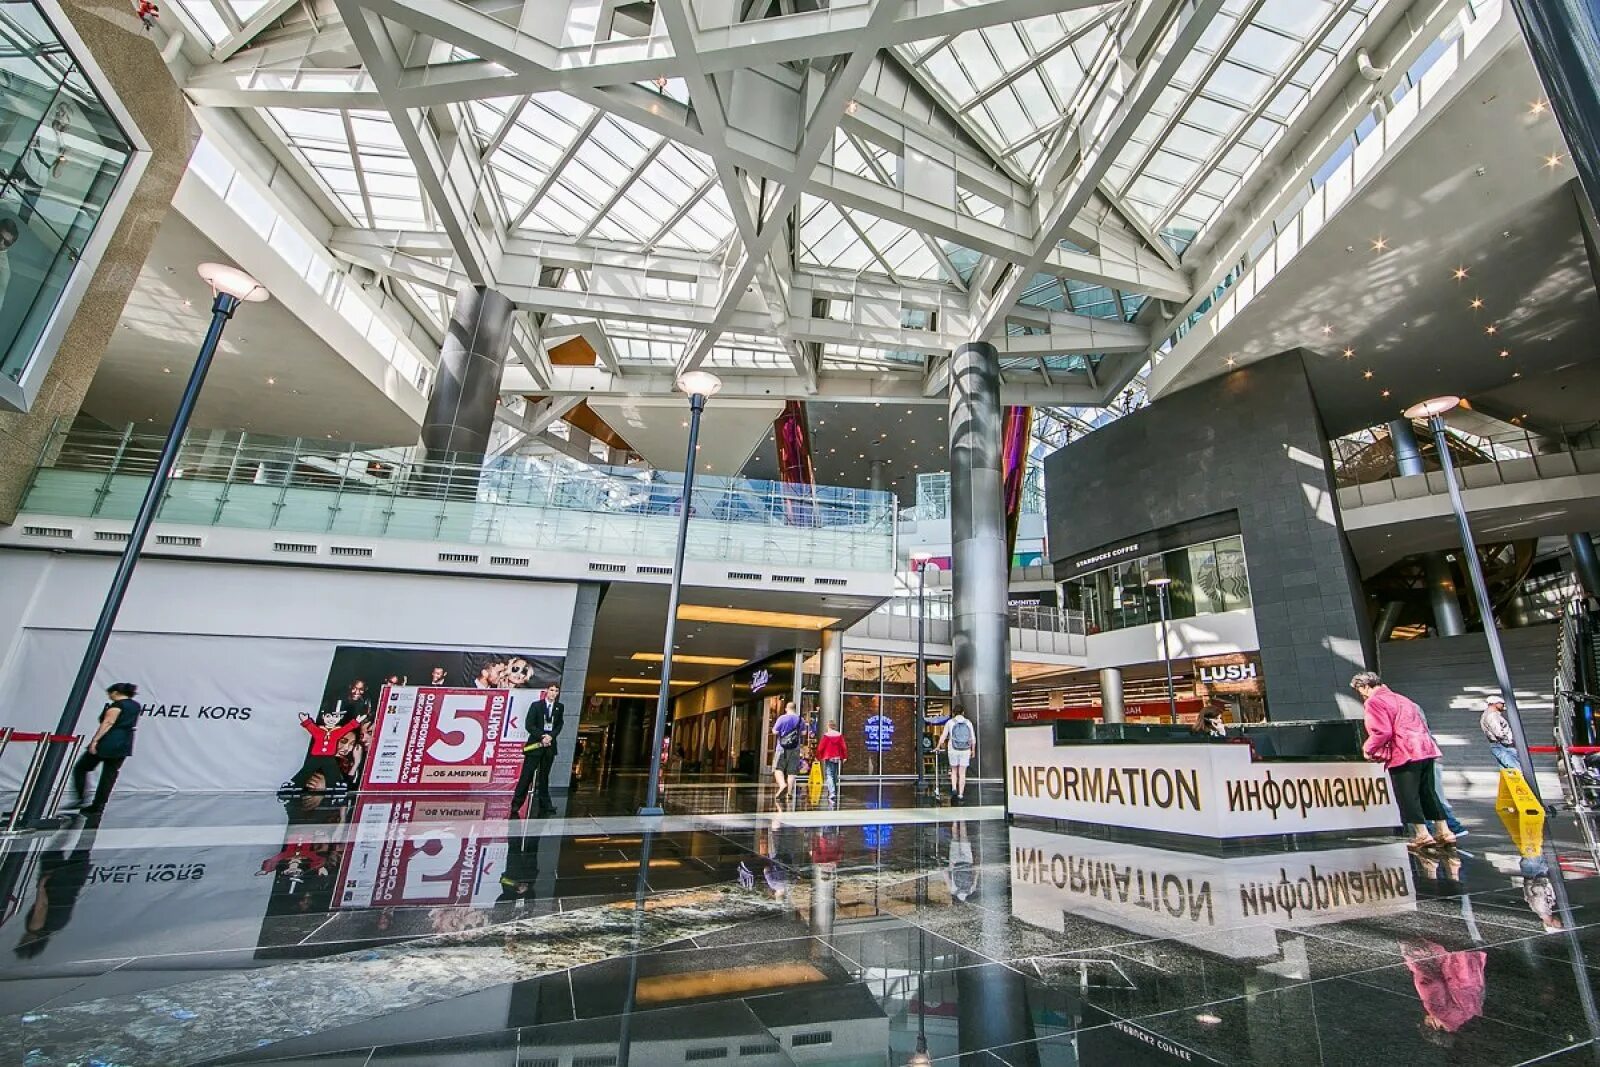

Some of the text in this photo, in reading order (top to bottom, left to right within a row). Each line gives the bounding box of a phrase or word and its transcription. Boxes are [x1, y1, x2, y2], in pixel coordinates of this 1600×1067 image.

[1076, 543, 1139, 568] STARBUCKS COFFEE
[1200, 662, 1257, 681] LUSH
[198, 706, 252, 720] KORS
[414, 693, 435, 762] МАЯКОВСКОГО
[426, 694, 488, 763] 5
[1012, 765, 1201, 811] INFORMATION
[1226, 770, 1391, 819] информация
